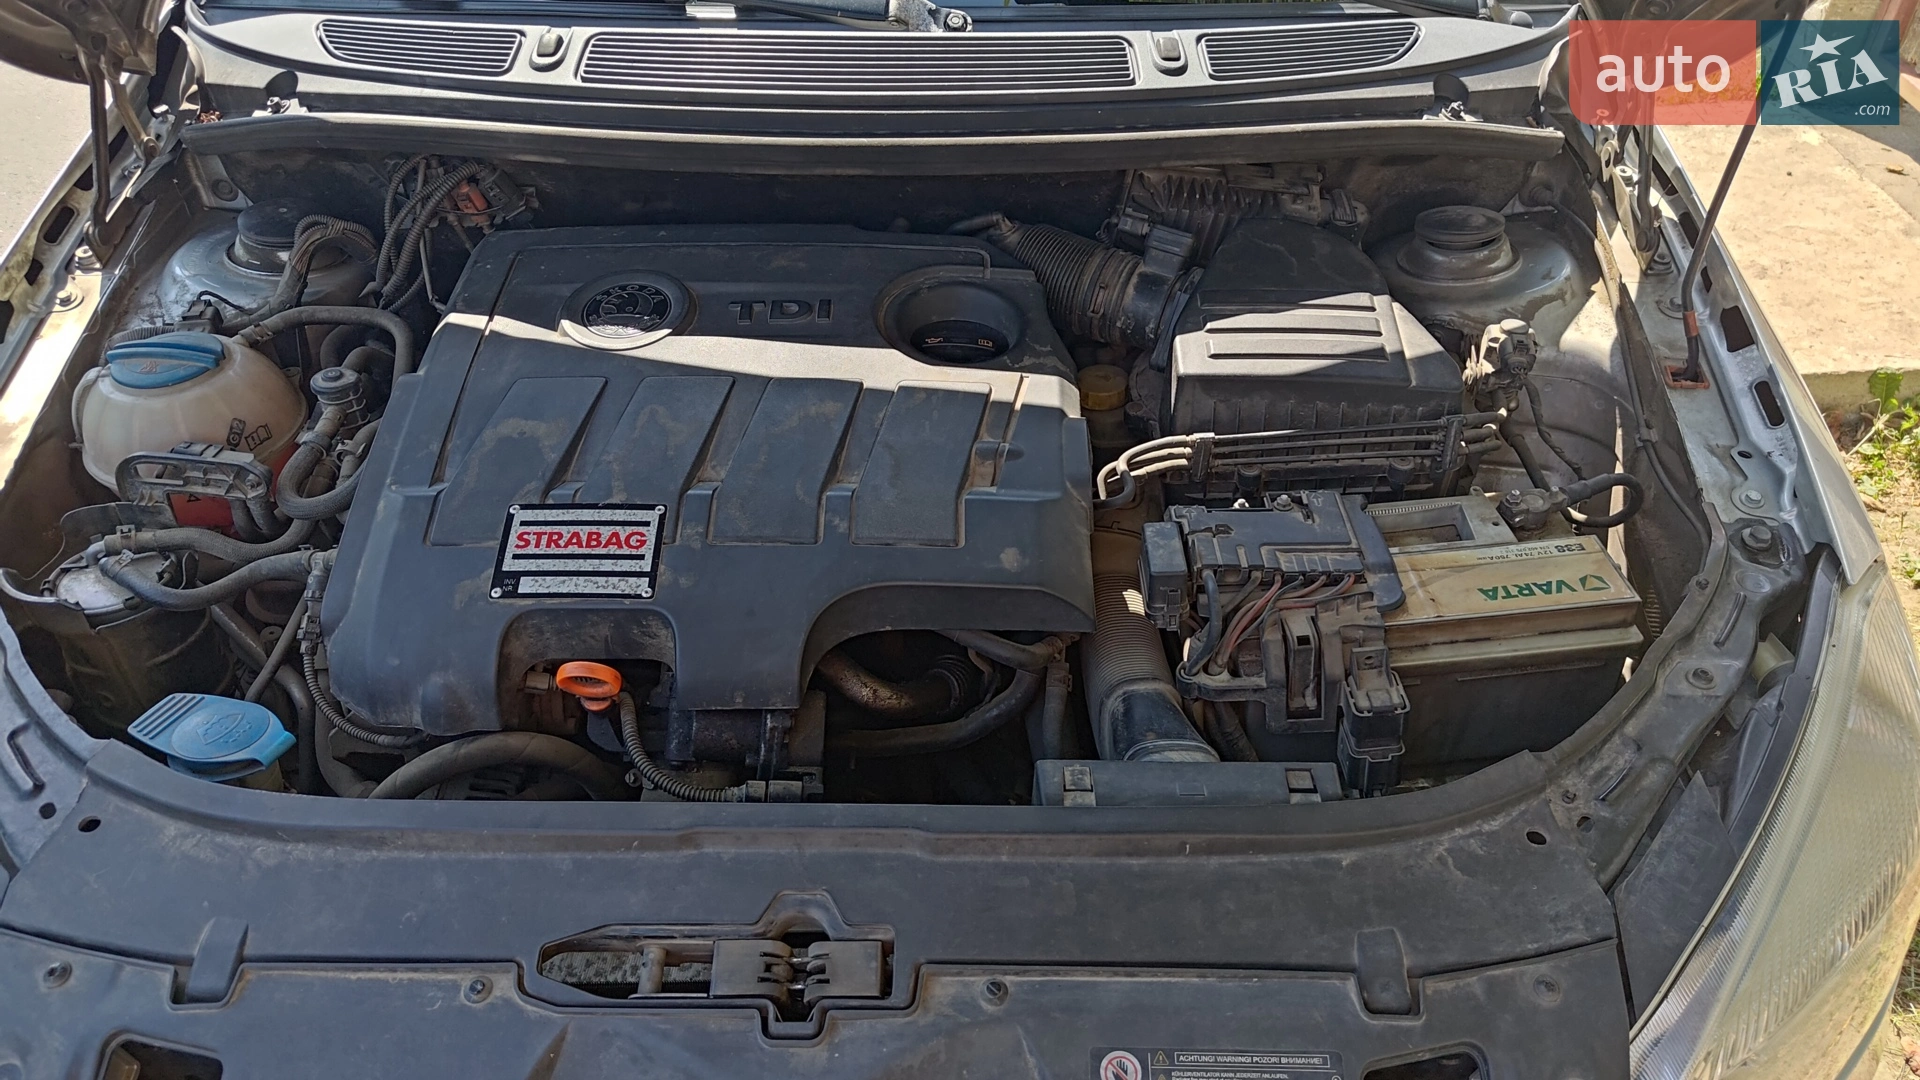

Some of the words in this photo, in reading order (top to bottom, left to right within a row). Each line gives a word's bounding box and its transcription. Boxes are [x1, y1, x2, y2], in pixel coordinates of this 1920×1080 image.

[728, 299, 833, 324] TDI
[514, 531, 648, 549] STRABAG
[1554, 543, 1586, 553] E38
[1477, 580, 1578, 601] VARTA
[1216, 1055, 1251, 1063] WARNING!
[1253, 1056, 1280, 1064] POZOR!
[1281, 1057, 1323, 1065] ВНИМАНИЕ!
